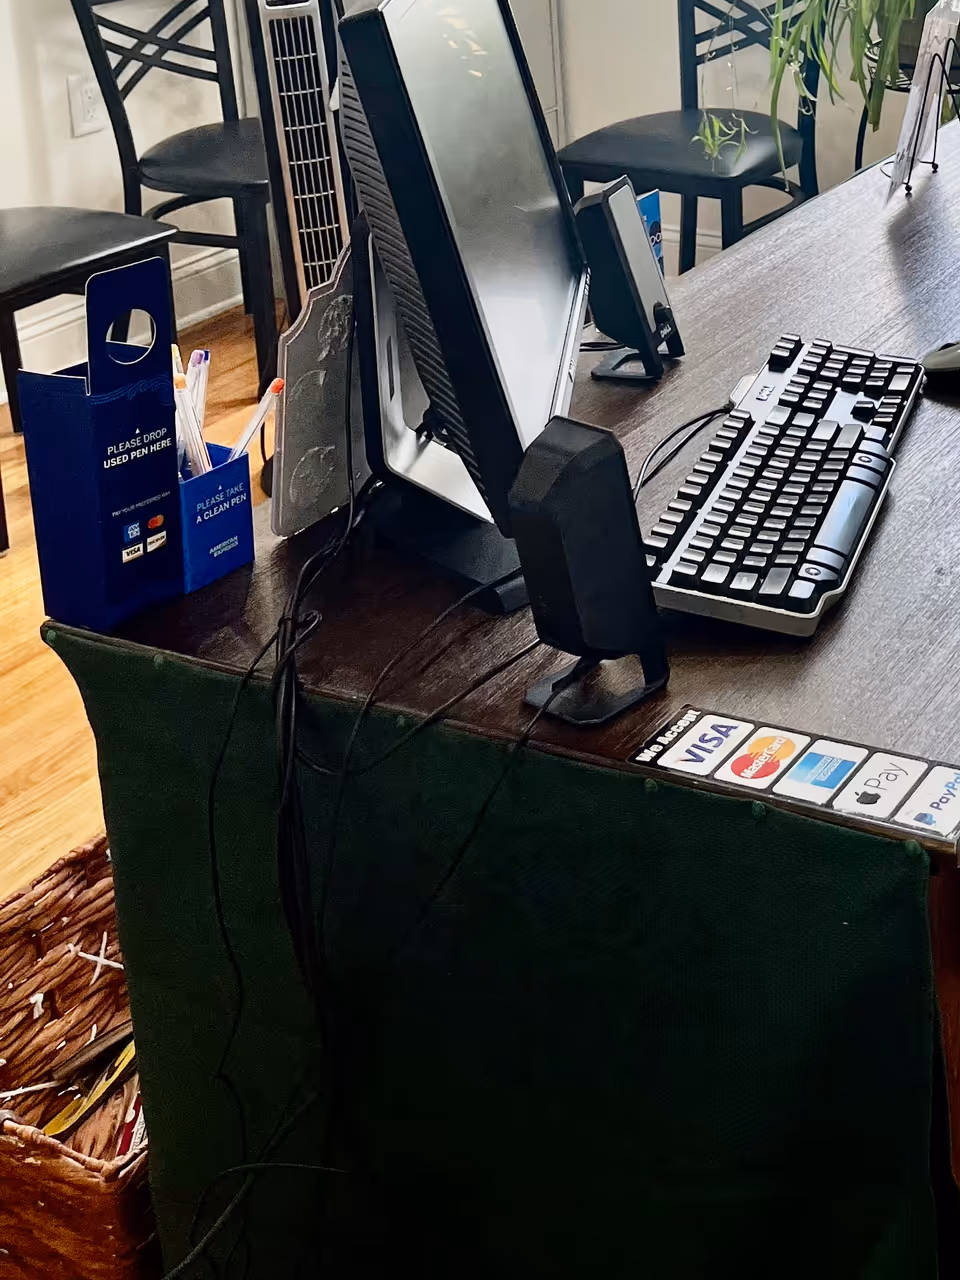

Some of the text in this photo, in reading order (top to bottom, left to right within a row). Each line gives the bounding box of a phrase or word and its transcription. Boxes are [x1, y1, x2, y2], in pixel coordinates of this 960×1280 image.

[103, 438, 172, 469] USED PEN HERE
[107, 427, 167, 456] PLEASE DROP
[196, 483, 244, 512] PLEASE TAKE
[196, 493, 247, 524] A CLEAN PEN
[125, 546, 142, 557] VISA
[635, 743, 664, 762] We
[674, 723, 739, 764] VISA
[740, 736, 788, 780] MasterCard
[864, 762, 910, 791] Pay
